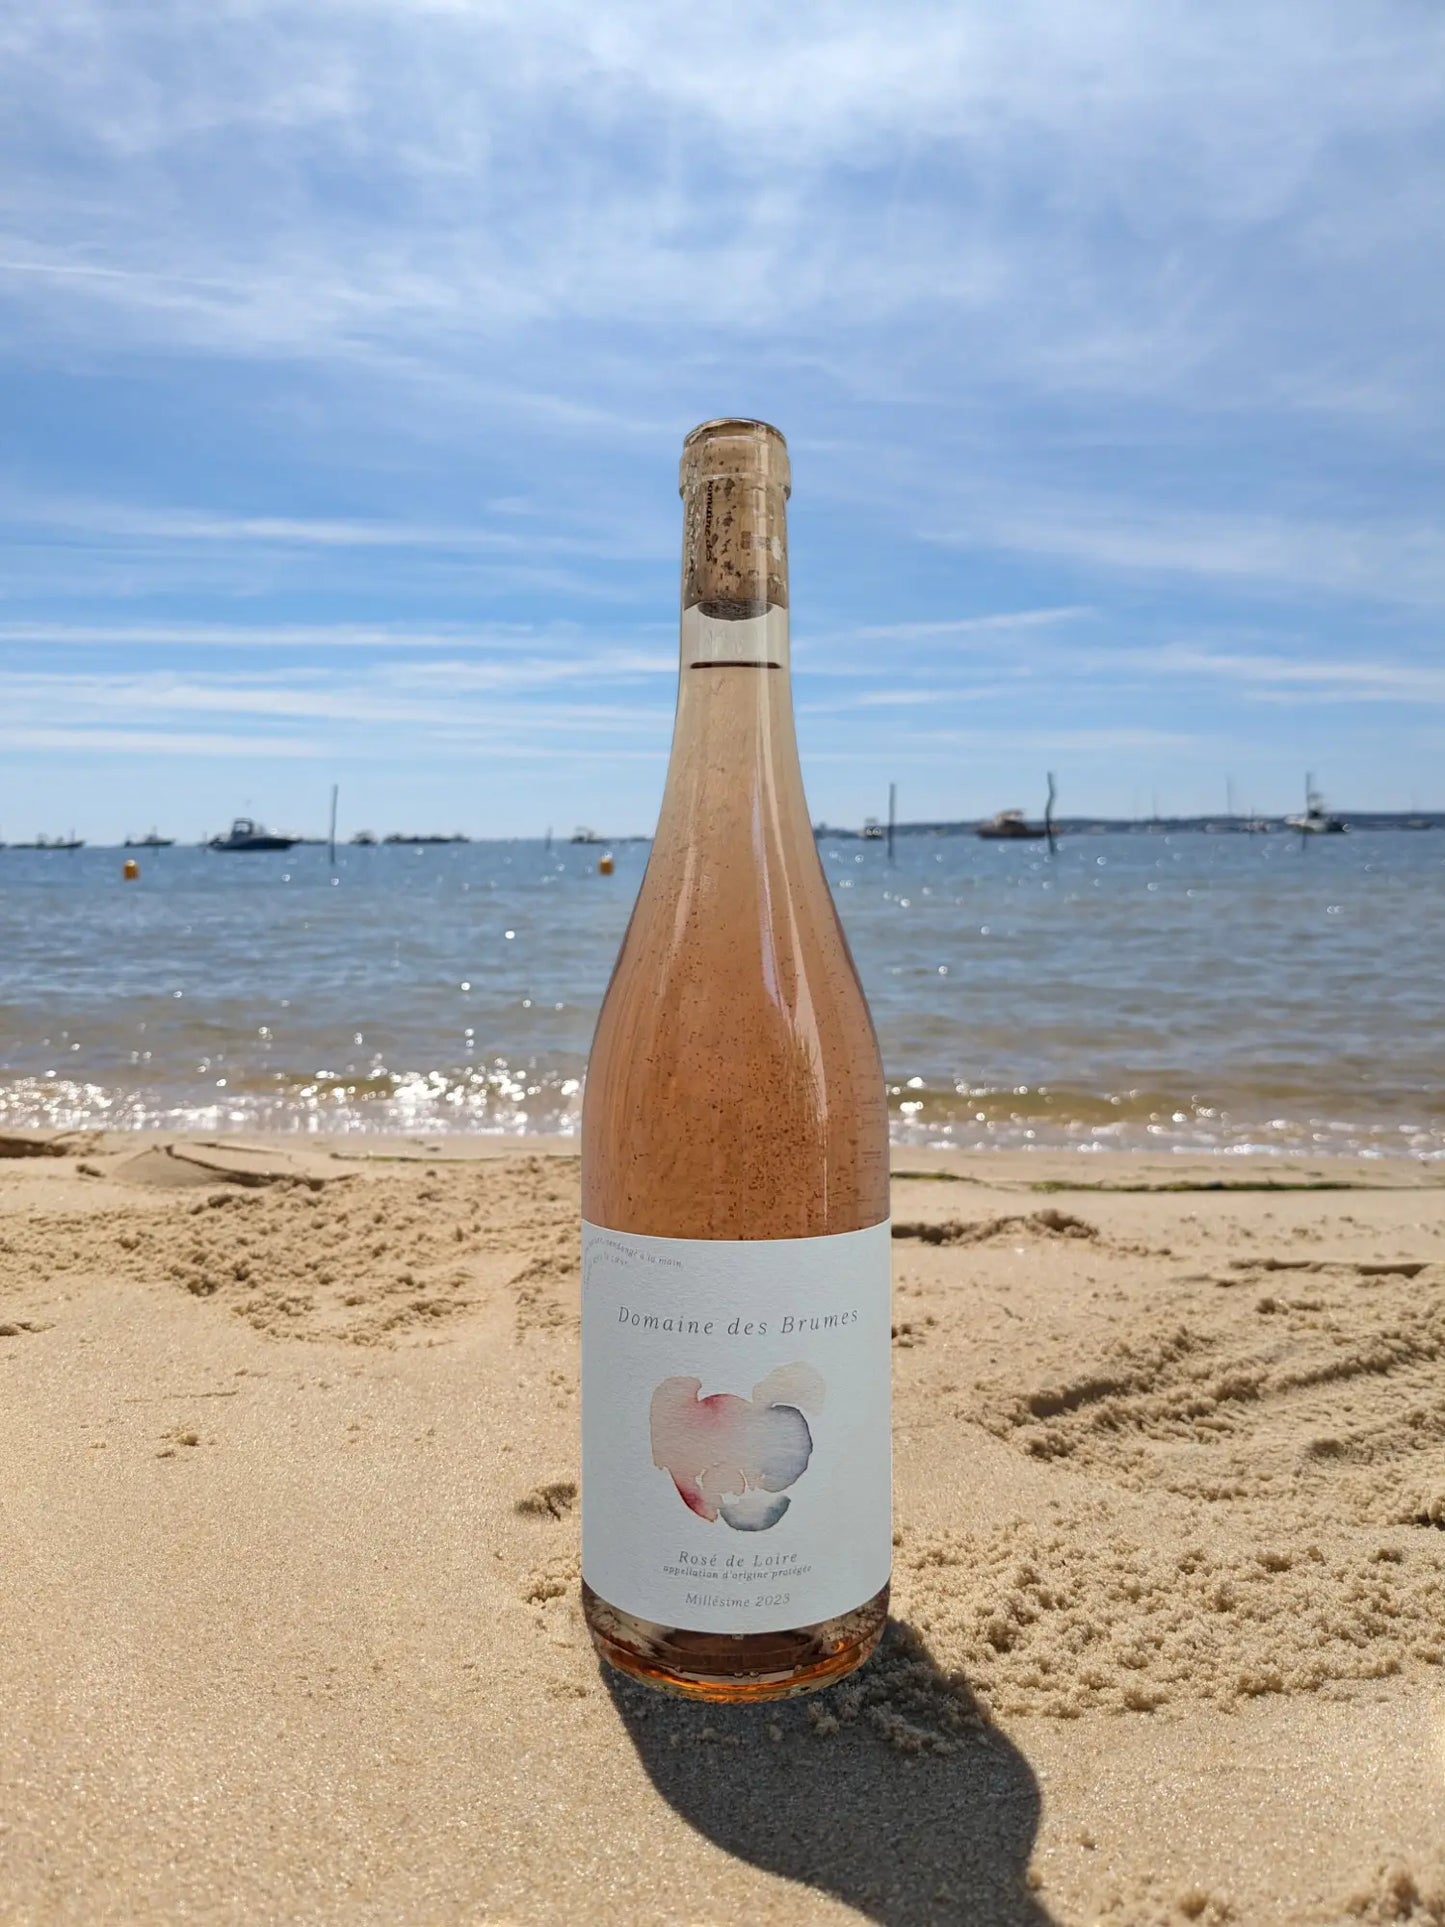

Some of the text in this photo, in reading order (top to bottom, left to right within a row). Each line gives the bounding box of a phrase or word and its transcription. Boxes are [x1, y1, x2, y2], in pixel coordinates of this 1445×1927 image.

[617, 1305, 859, 1336] Domaine des Brumes
[678, 1550, 798, 1568] Rosé de Loire
[663, 1564, 813, 1582] appellation d'origine protégée
[685, 1592, 791, 1608] Millésime 2023
